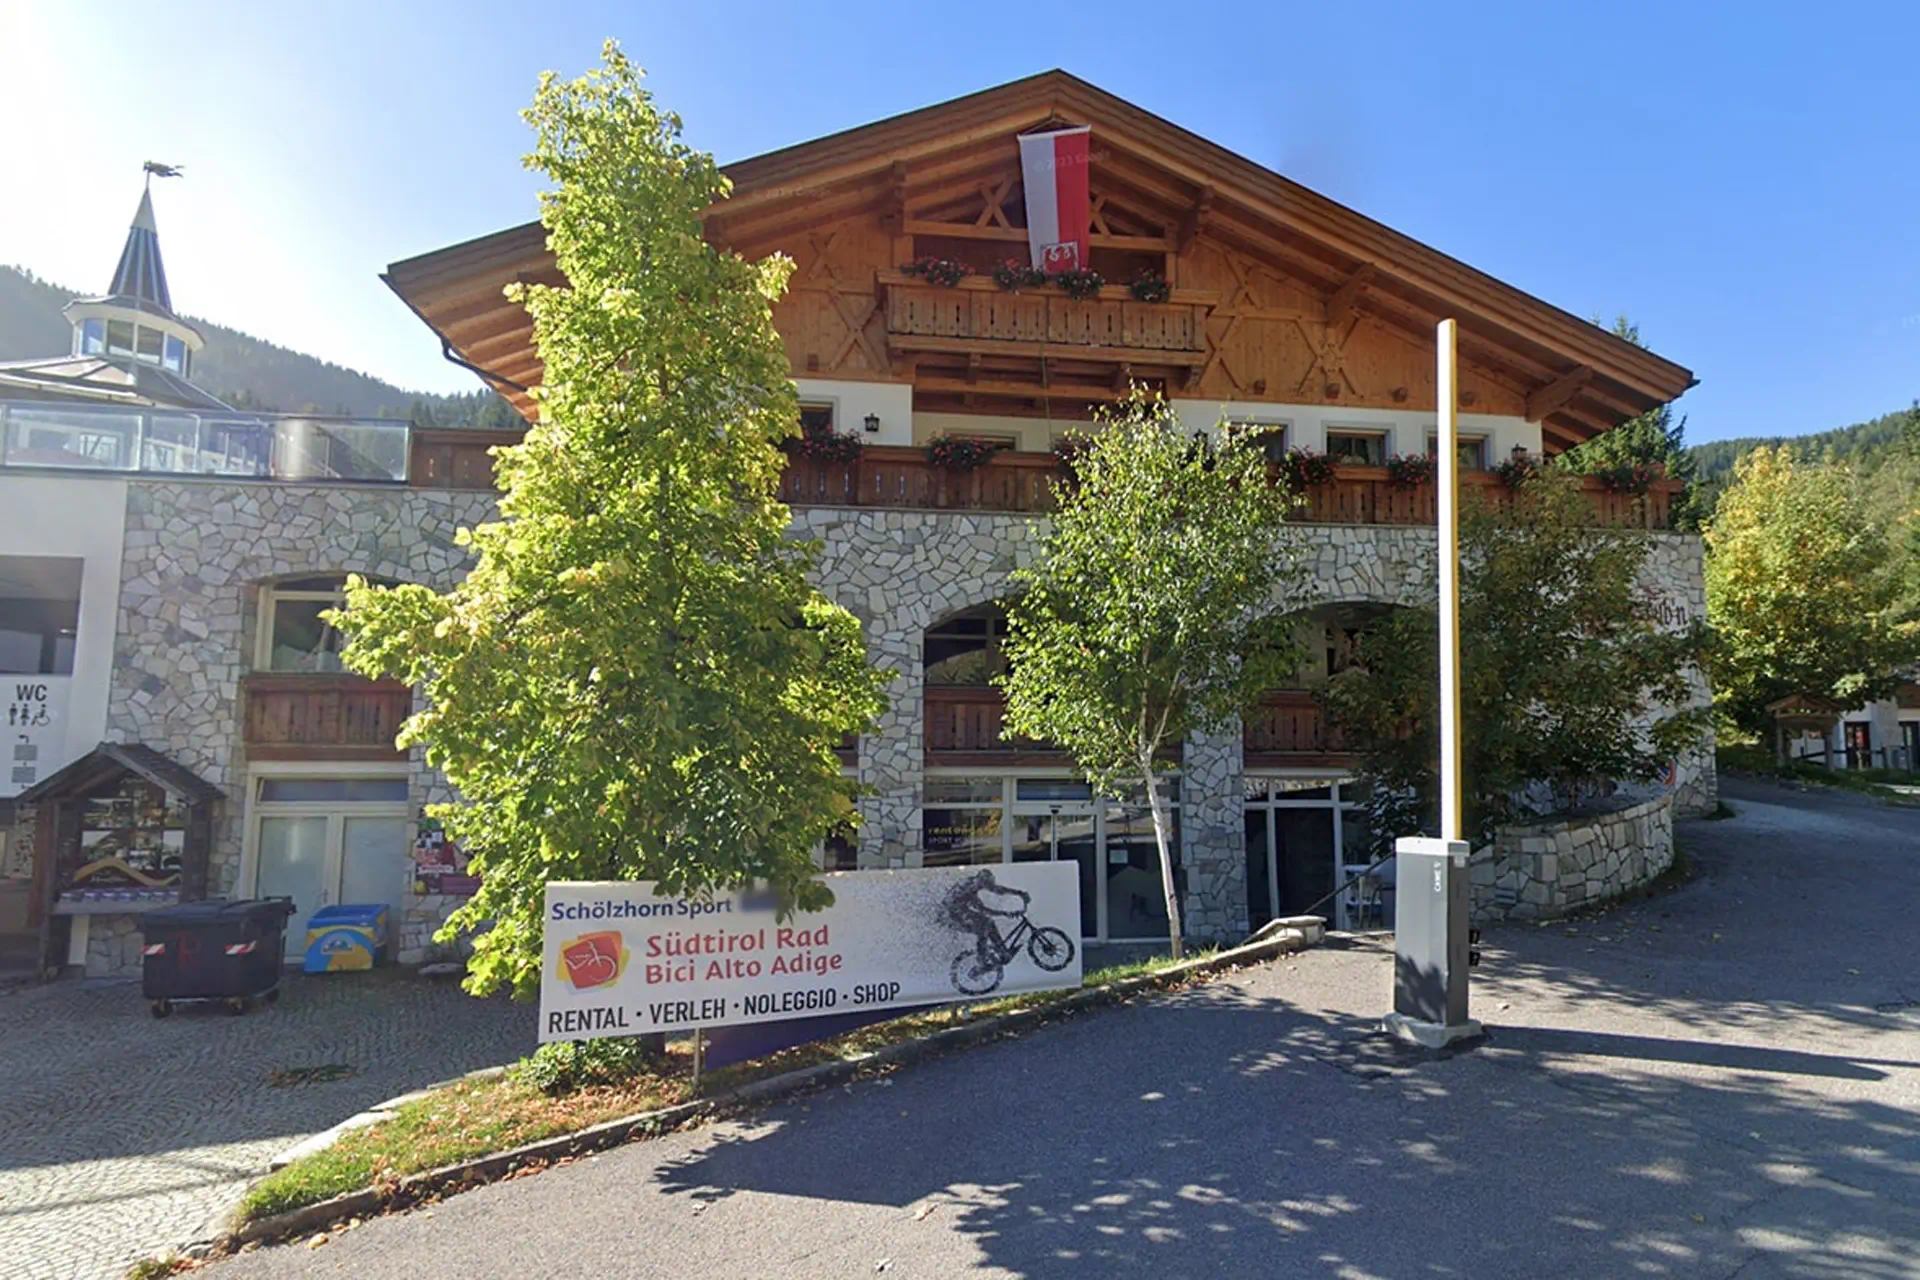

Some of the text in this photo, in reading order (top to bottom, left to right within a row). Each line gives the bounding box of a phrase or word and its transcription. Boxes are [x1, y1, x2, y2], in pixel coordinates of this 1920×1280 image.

[16, 684, 48, 702] WC
[551, 898, 733, 920] Schölzhorn Sport
[646, 924, 829, 957] Südtirol Rad
[645, 951, 843, 985] Bici Alto Adige
[549, 982, 902, 1033] RENTAL VERLEH NOLEGGIO SHOP
